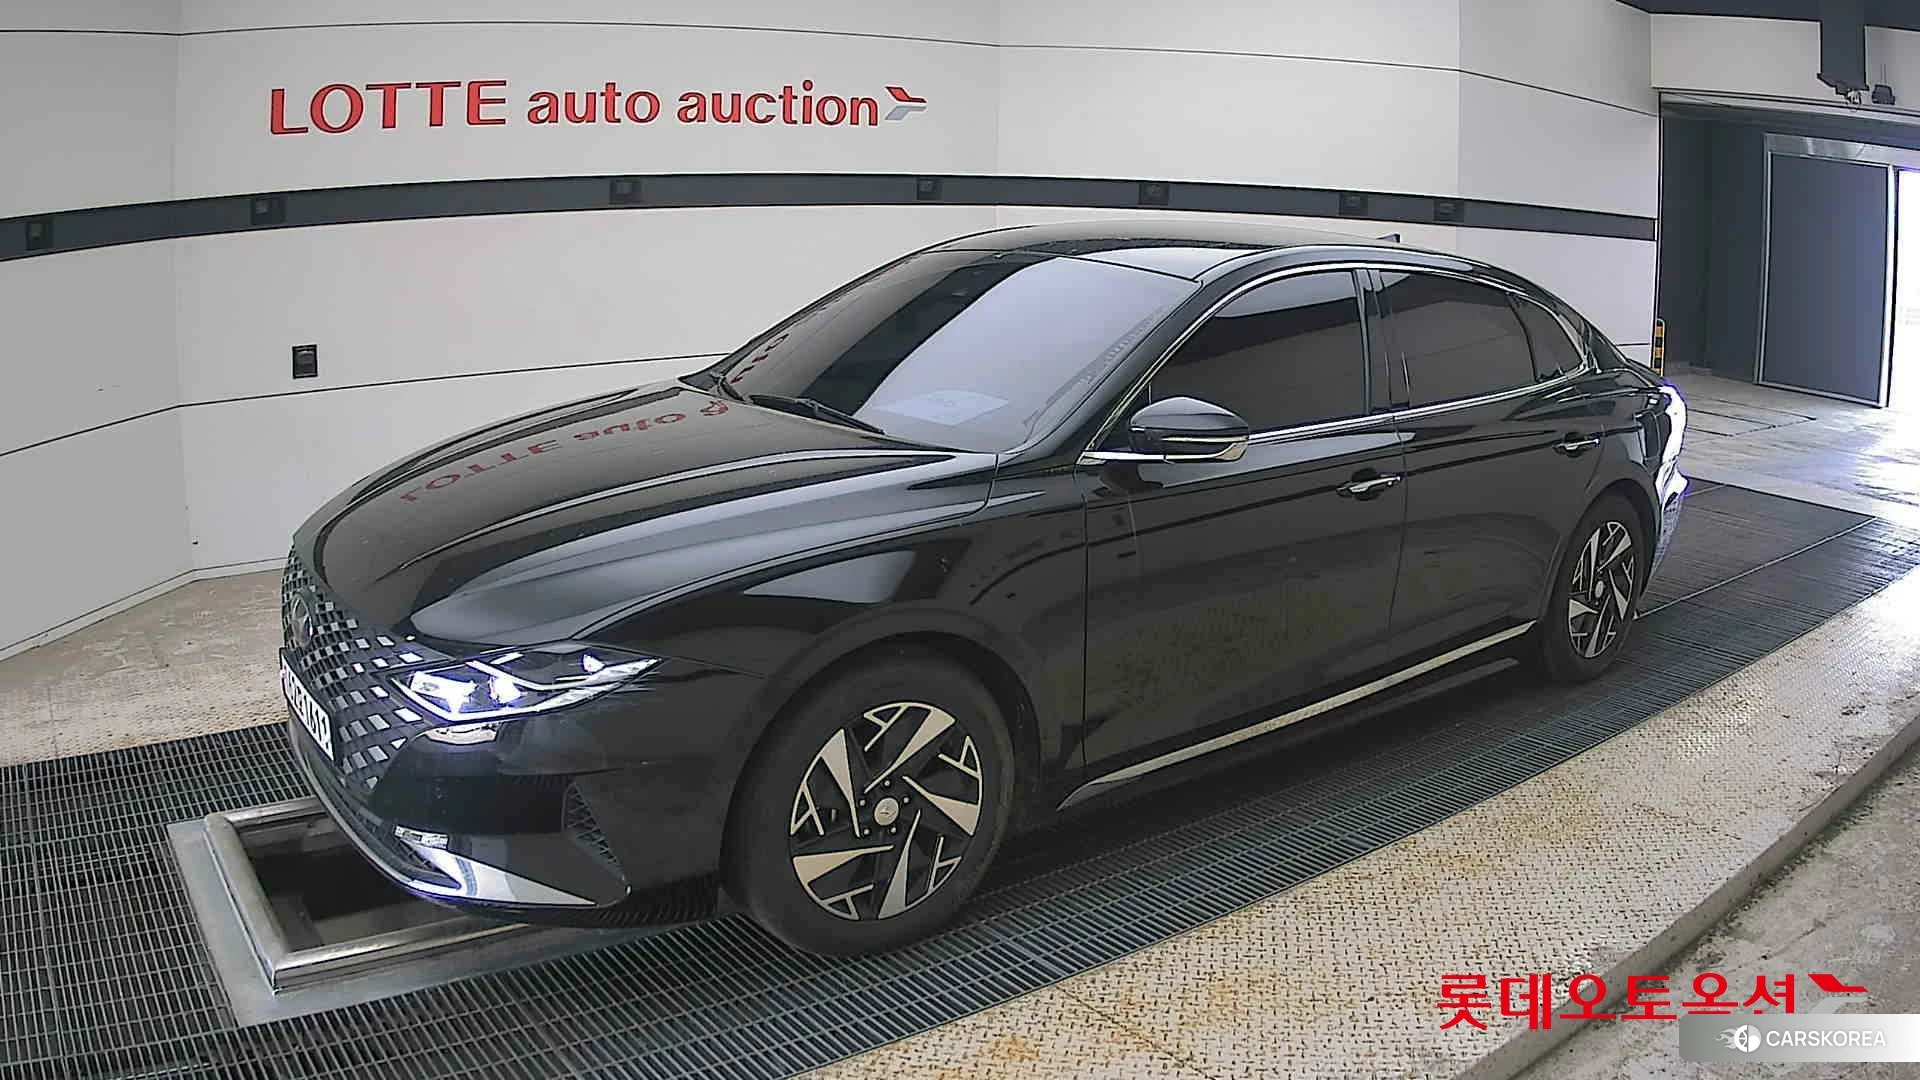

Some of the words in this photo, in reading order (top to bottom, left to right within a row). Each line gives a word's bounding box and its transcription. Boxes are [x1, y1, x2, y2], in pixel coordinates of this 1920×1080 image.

[270, 80, 507, 135] LOTTE
[527, 82, 661, 124] auto
[677, 79, 880, 127] auction
